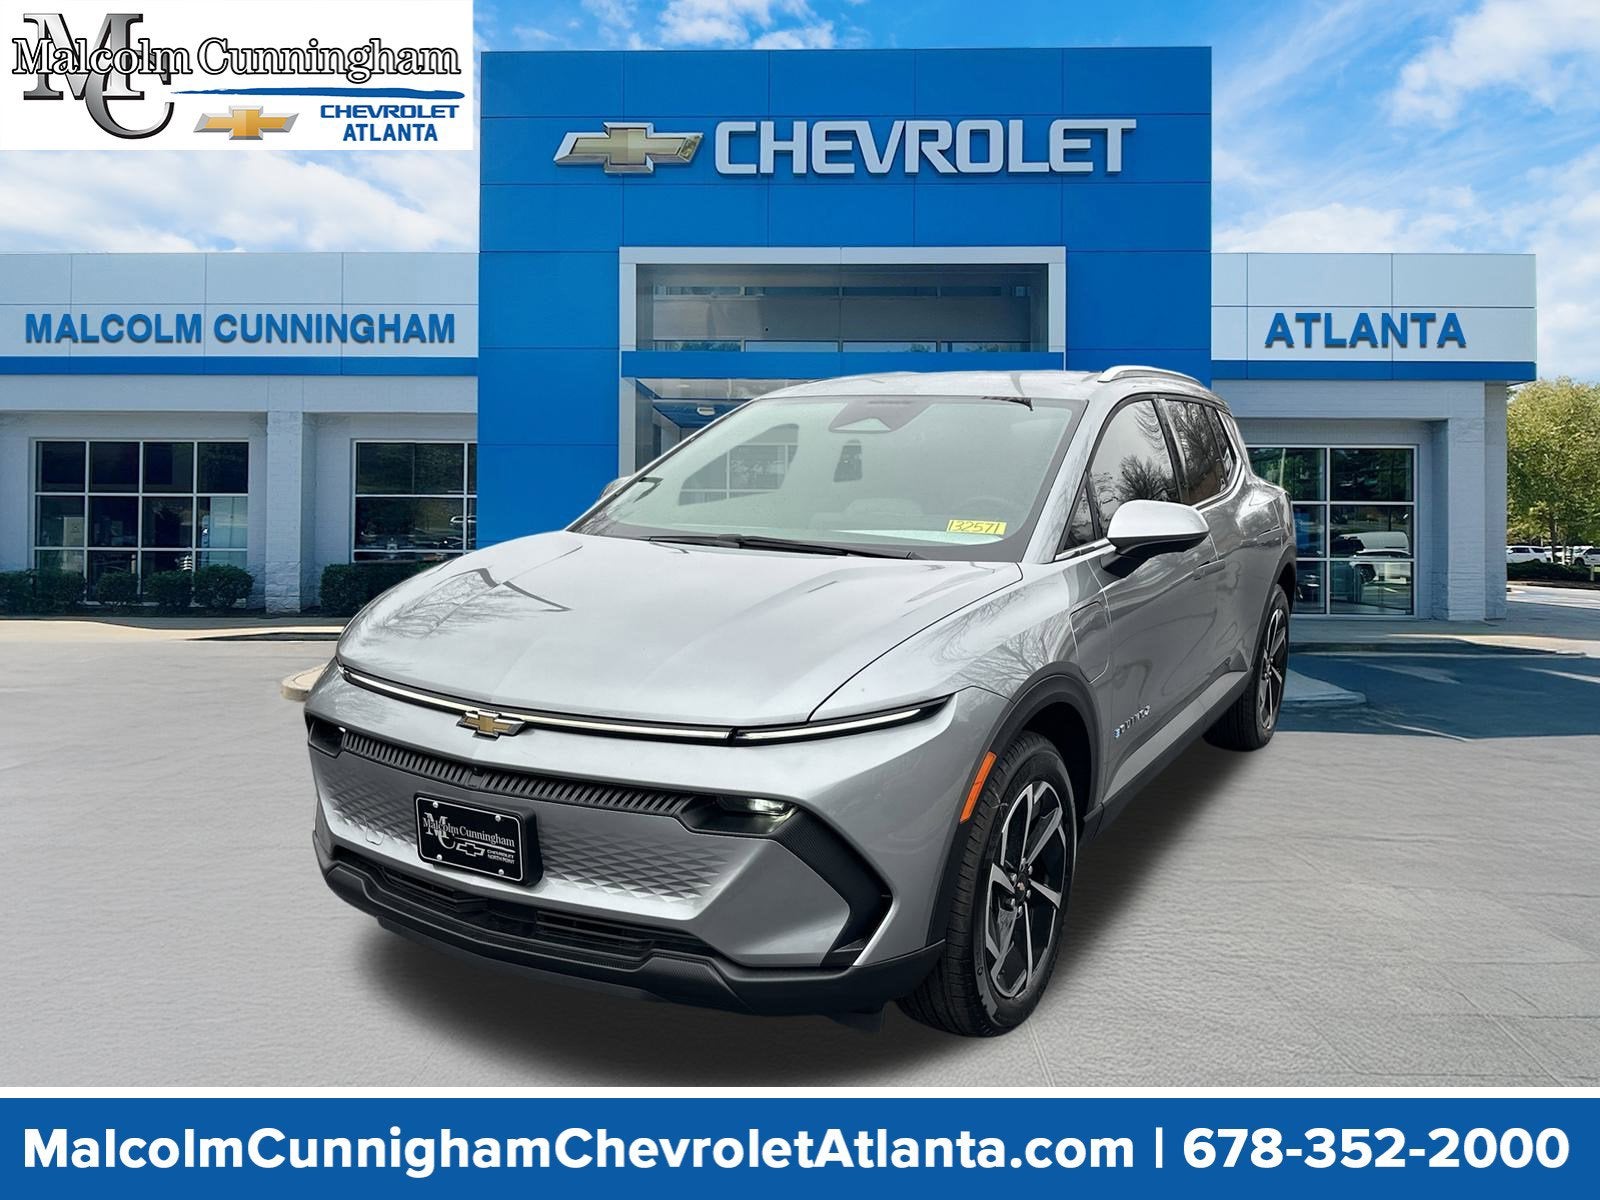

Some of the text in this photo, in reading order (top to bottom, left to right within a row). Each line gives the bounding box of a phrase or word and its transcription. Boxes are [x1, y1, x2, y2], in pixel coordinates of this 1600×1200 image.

[715, 119, 1137, 175] CHEVROLET
[25, 313, 455, 344] MALCOLM CUNNINGHAM
[1264, 312, 1467, 349] ATLANTA
[423, 817, 515, 848] Malcolm Cunningham
